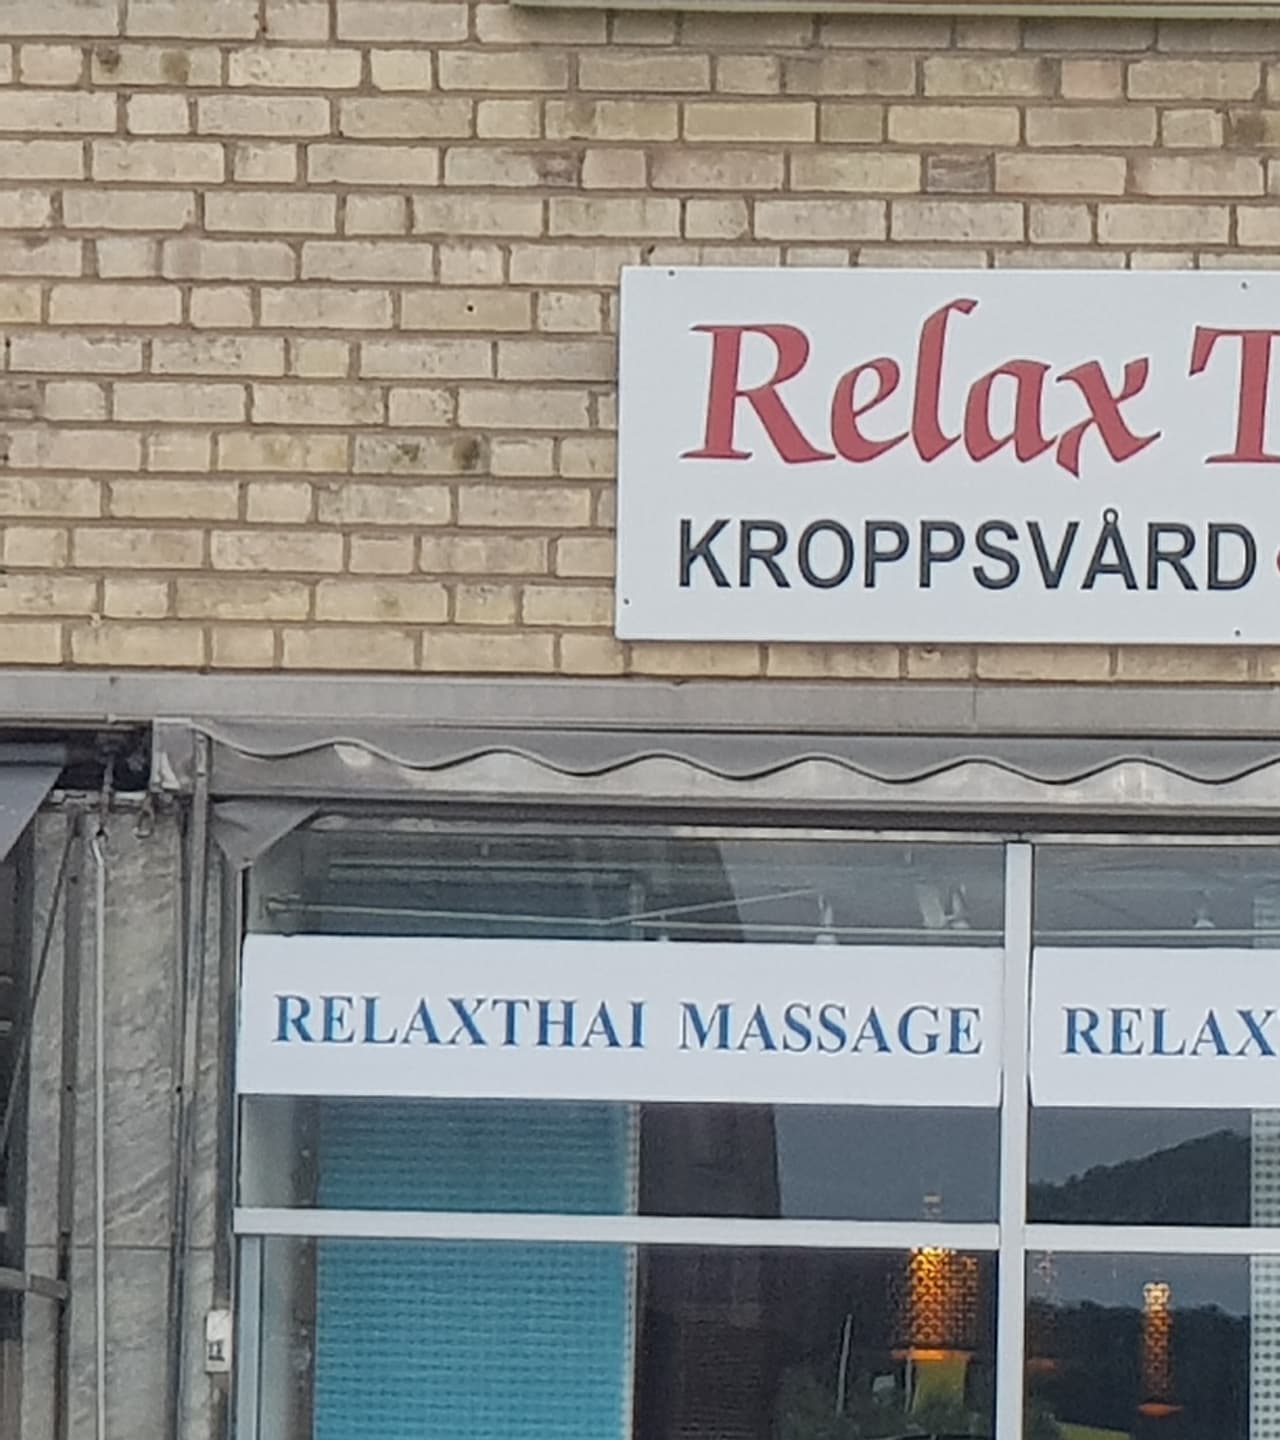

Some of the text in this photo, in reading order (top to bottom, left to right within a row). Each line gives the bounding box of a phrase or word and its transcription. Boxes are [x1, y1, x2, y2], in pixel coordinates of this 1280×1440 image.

[678, 507, 1258, 592] KROPPSVÅRD
[271, 994, 982, 1055] RELAXTHAI MASSAGE
